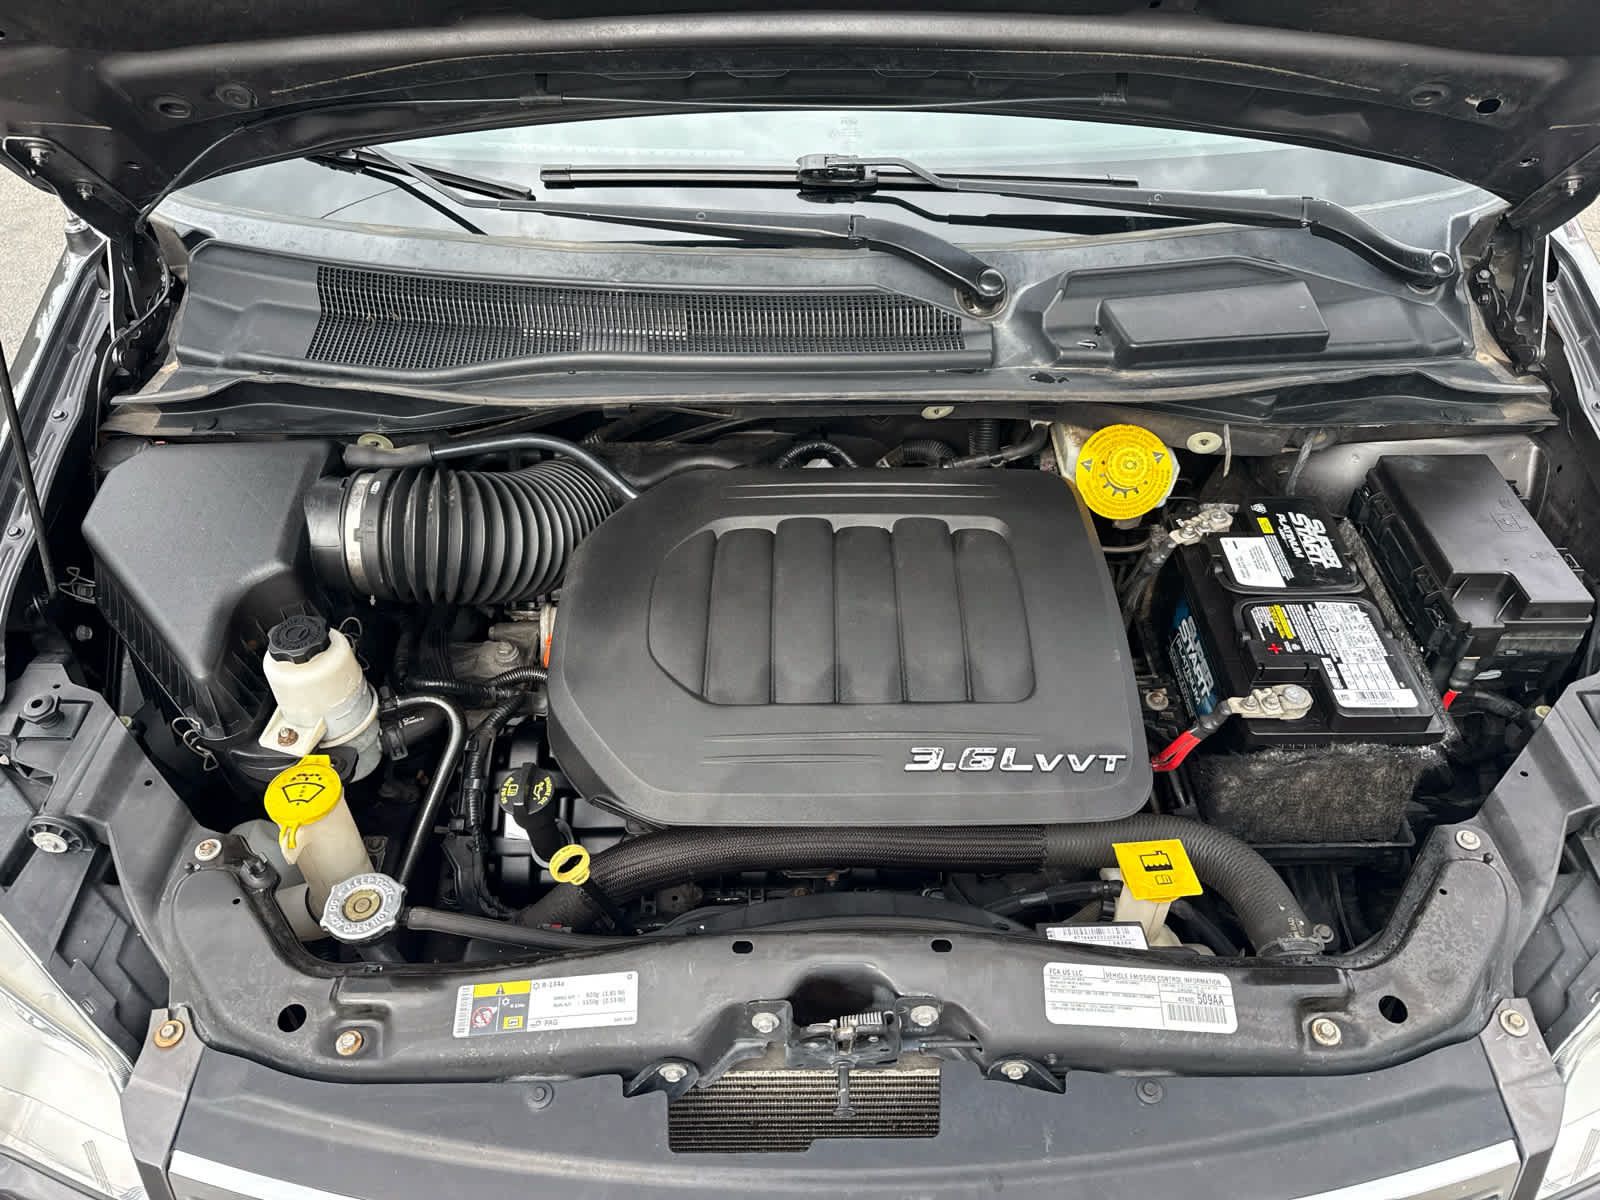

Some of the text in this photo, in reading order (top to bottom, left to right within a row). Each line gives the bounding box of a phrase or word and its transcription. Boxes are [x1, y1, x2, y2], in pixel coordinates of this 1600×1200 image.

[1276, 513, 1304, 558] PLATINUM
[1288, 511, 1331, 568] START
[1310, 519, 1343, 569] SUPER
[1178, 618, 1210, 697] START
[1049, 967, 1061, 976] FCA
[1105, 971, 1129, 980] VEHICLE
[1129, 973, 1156, 983] EMISSION
[1157, 975, 1182, 985] CONTROL
[1183, 977, 1222, 985] INFORMATION
[1197, 992, 1225, 1006] 509AA
